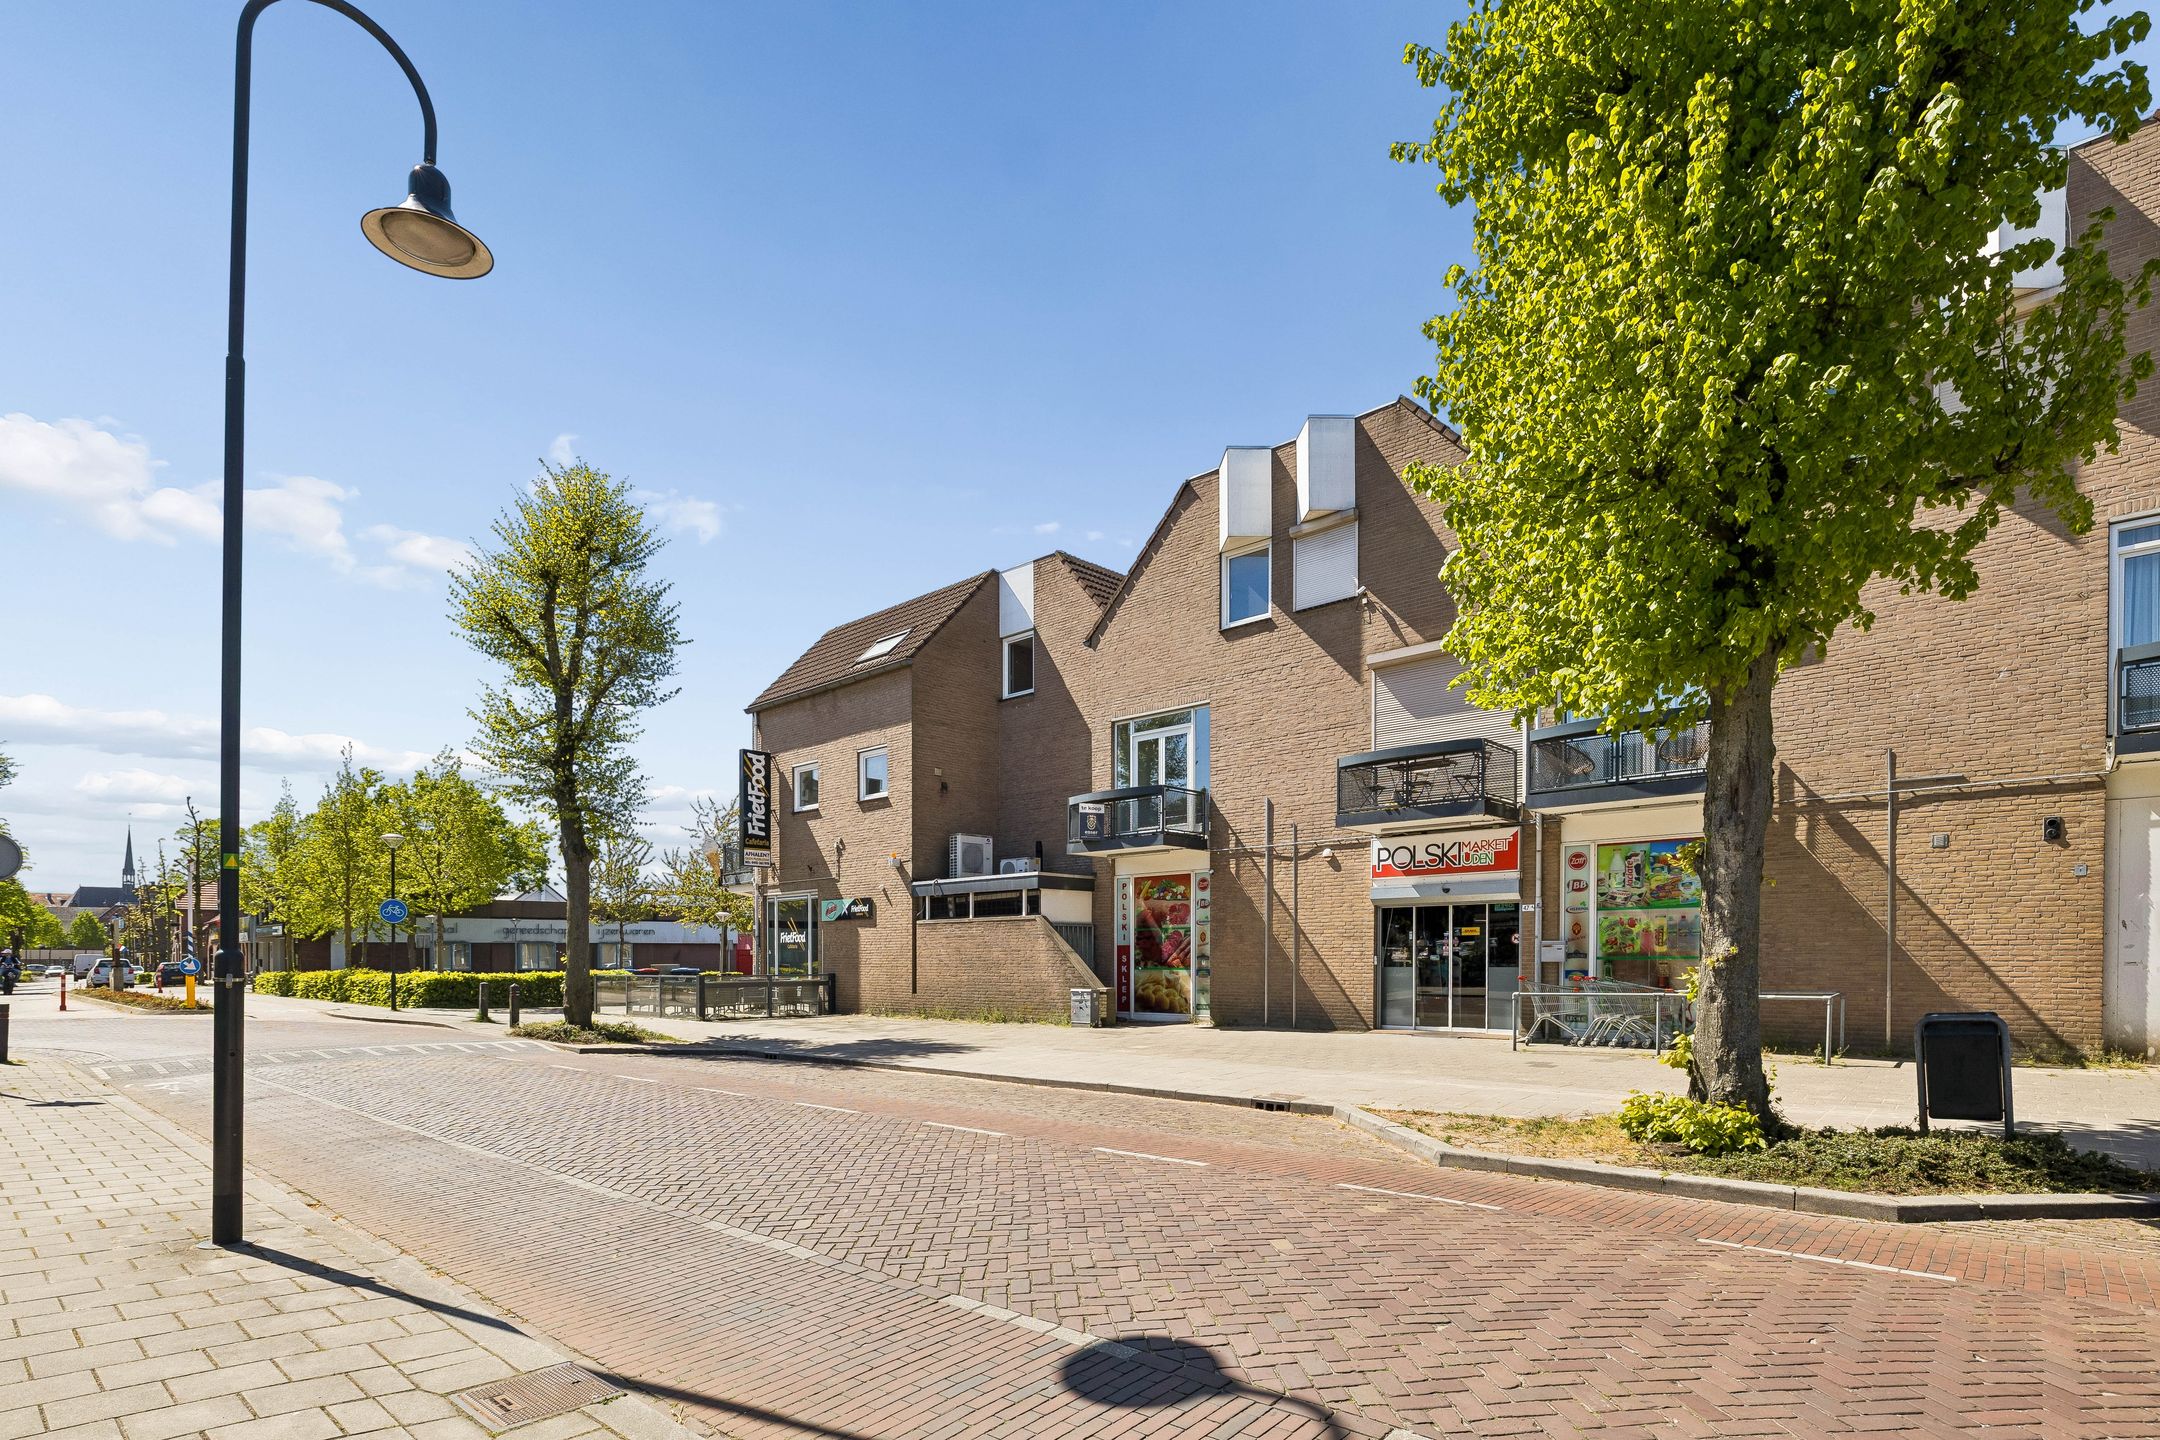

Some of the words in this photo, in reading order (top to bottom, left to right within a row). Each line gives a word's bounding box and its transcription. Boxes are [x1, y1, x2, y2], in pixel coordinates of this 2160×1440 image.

[747, 752, 766, 836] FrietFood
[1377, 841, 1462, 871] POLSKI
[1461, 838, 1512, 853] MARKET
[1461, 851, 1494, 865] UDEN
[780, 931, 807, 944] FrietFood
